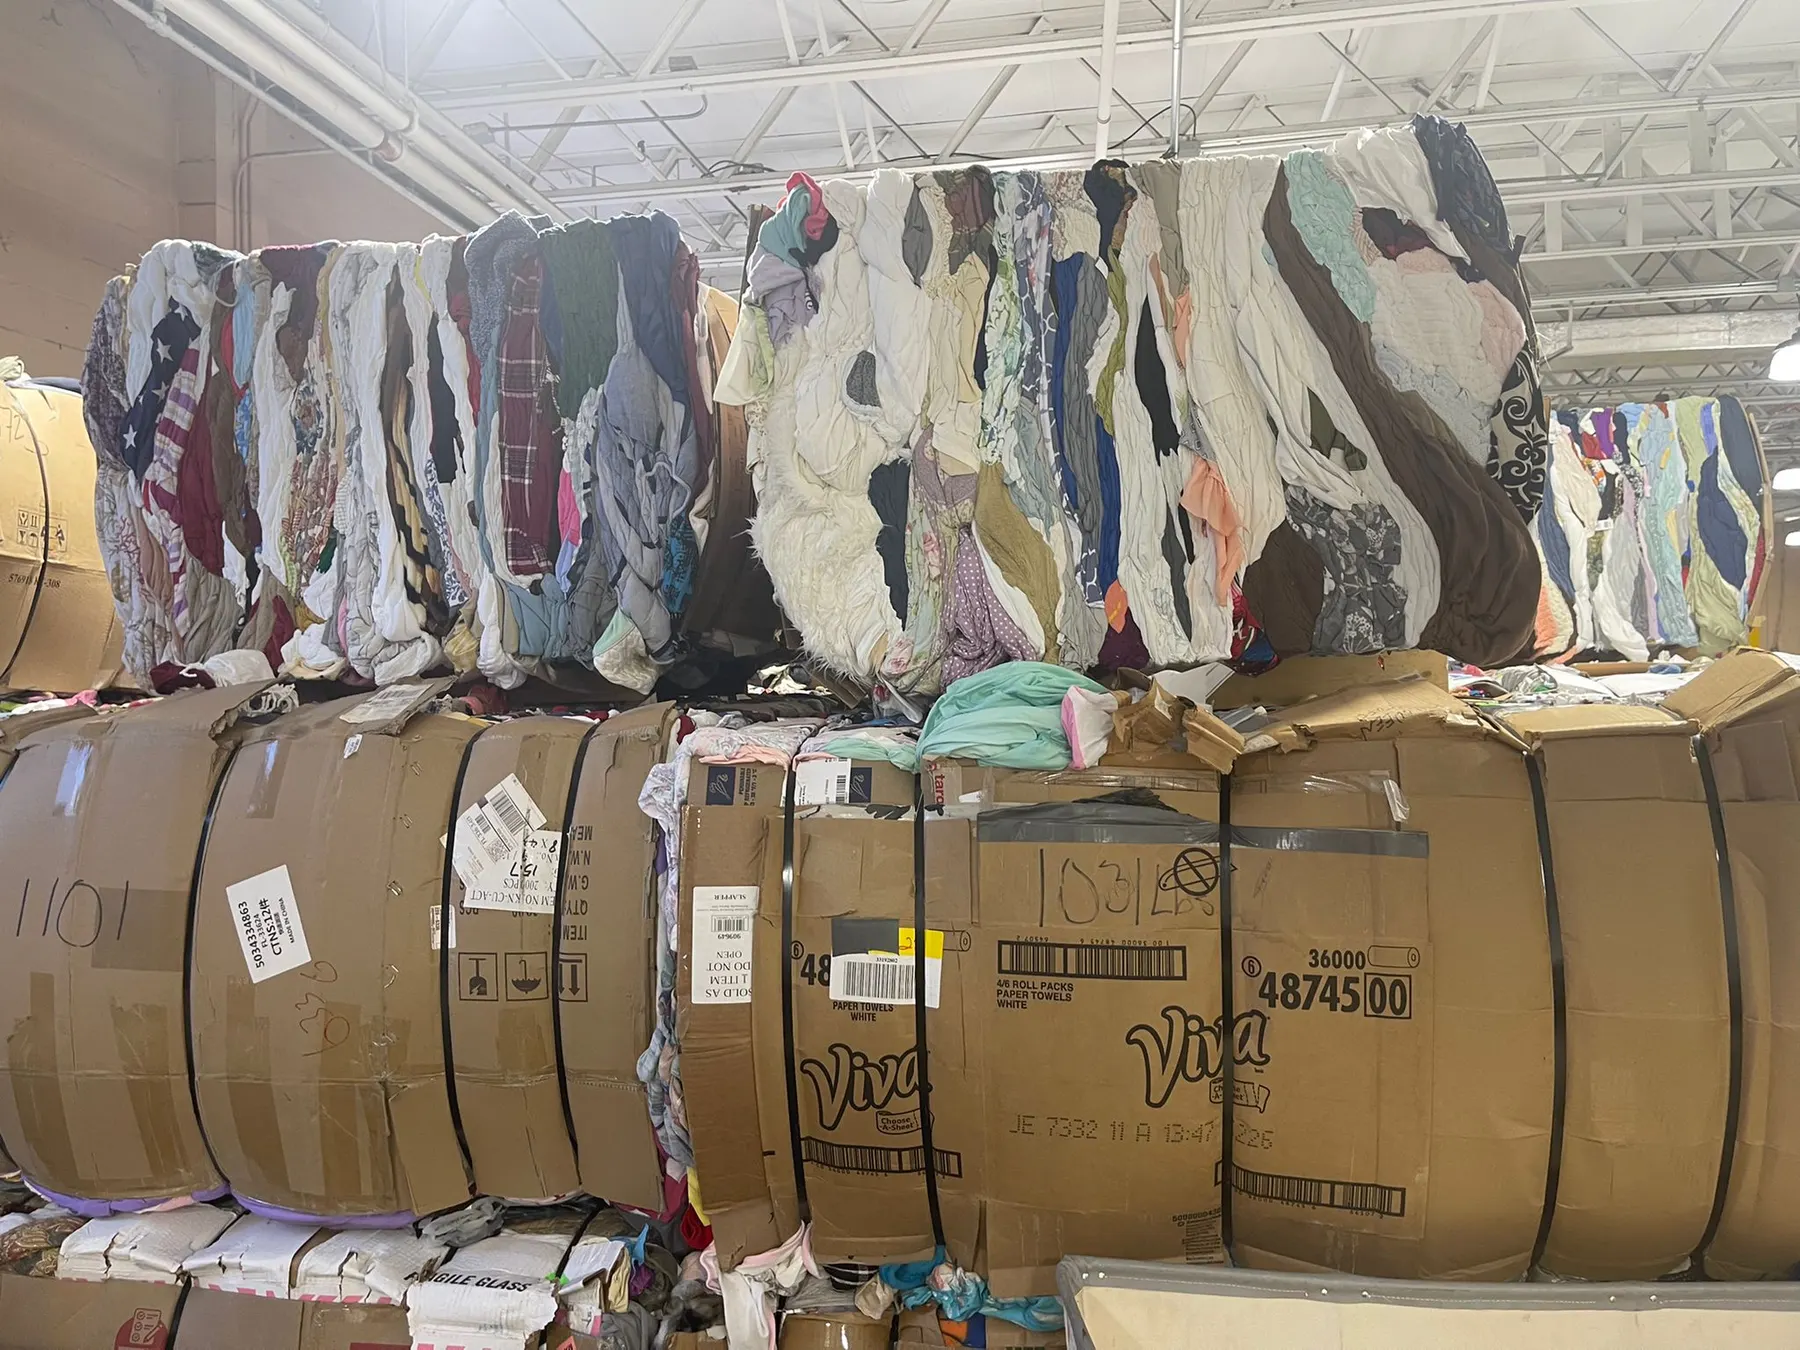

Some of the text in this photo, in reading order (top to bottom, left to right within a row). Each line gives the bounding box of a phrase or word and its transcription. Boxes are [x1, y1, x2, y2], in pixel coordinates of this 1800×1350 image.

[1039, 848, 1140, 928] 1031
[16, 877, 129, 948] 1101
[278, 897, 286, 917] CHINA
[237, 901, 265, 969] 5034334863
[286, 924, 295, 944] MADE
[716, 950, 743, 959] OPEN
[1308, 949, 1366, 970] 36000
[706, 962, 751, 972] DO NOT
[710, 974, 749, 985] 1 ITEM
[996, 979, 1074, 992] 4/6 ROLL PACKS
[705, 988, 721, 998] AS
[996, 990, 1072, 1002] PAPER TOWELS
[1258, 971, 1361, 1013] 48745
[1368, 977, 1408, 1016] 00
[832, 1001, 894, 1012] PAPER TOWELS
[996, 1000, 1028, 1010] WHITE
[851, 1012, 877, 1022] WHITE
[1126, 1005, 1271, 1108] Viva
[800, 1043, 933, 1131] Viva
[881, 1117, 911, 1125] Choose
[1047, 1116, 1098, 1140] 7332
[475, 1277, 532, 1292] GLASS
